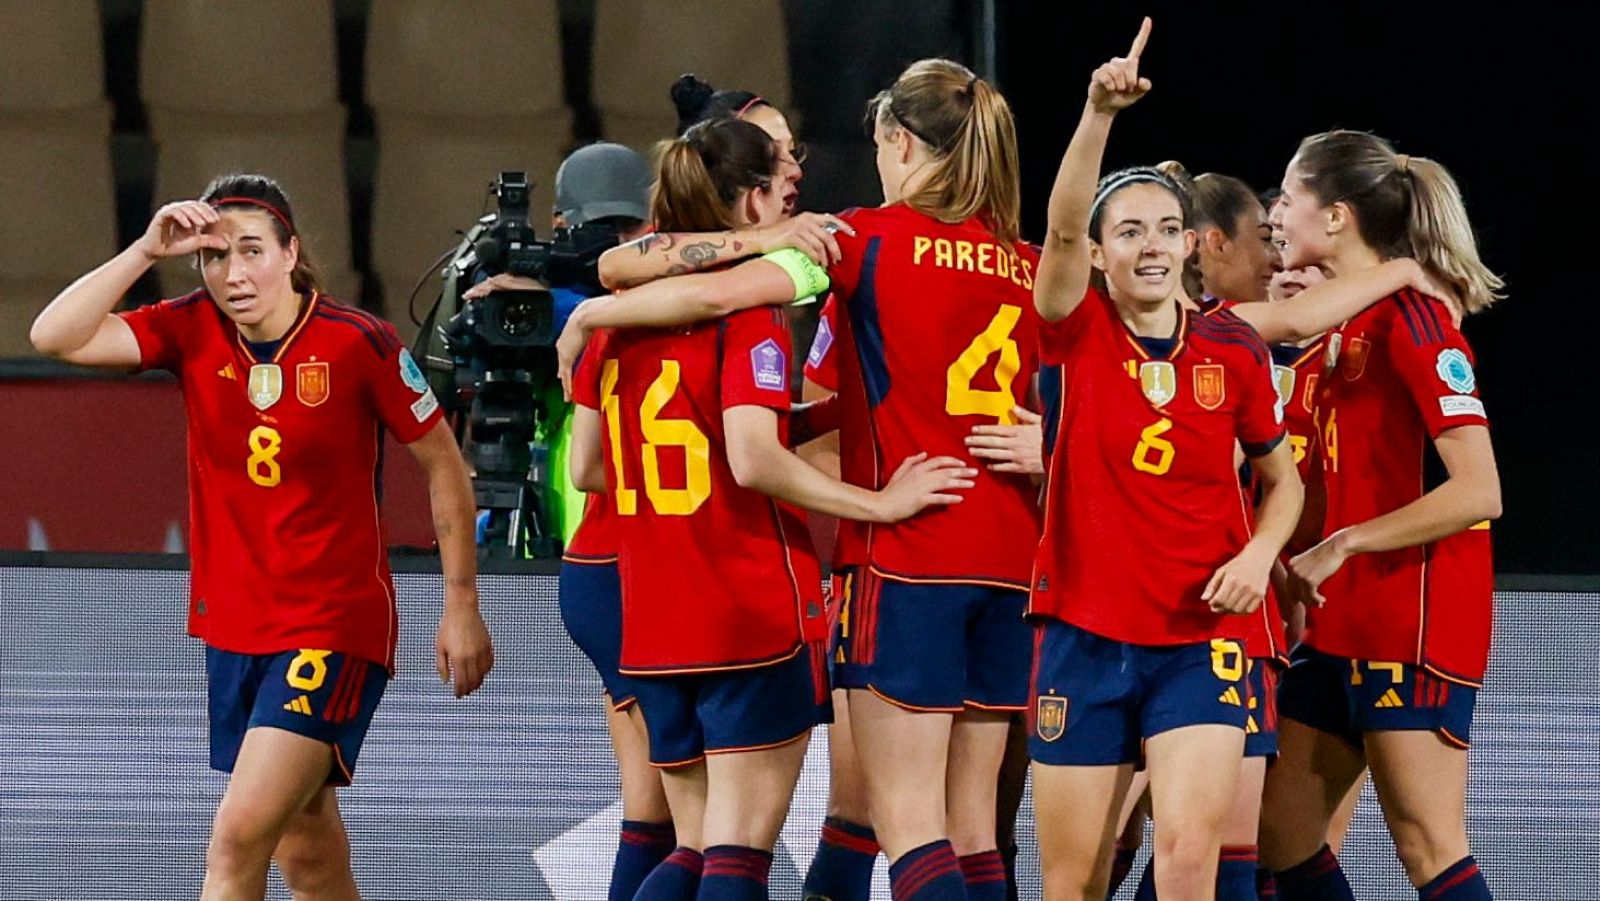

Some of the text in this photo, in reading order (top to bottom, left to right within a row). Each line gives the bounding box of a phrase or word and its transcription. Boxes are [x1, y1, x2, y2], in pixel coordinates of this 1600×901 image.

[913, 236, 1033, 291] PAREDES
[946, 303, 1022, 426] 4
[247, 425, 282, 487] 8
[600, 359, 711, 516] 16
[1132, 417, 1175, 475] 6
[286, 648, 333, 692] 8
[1210, 638, 1243, 682] 6
